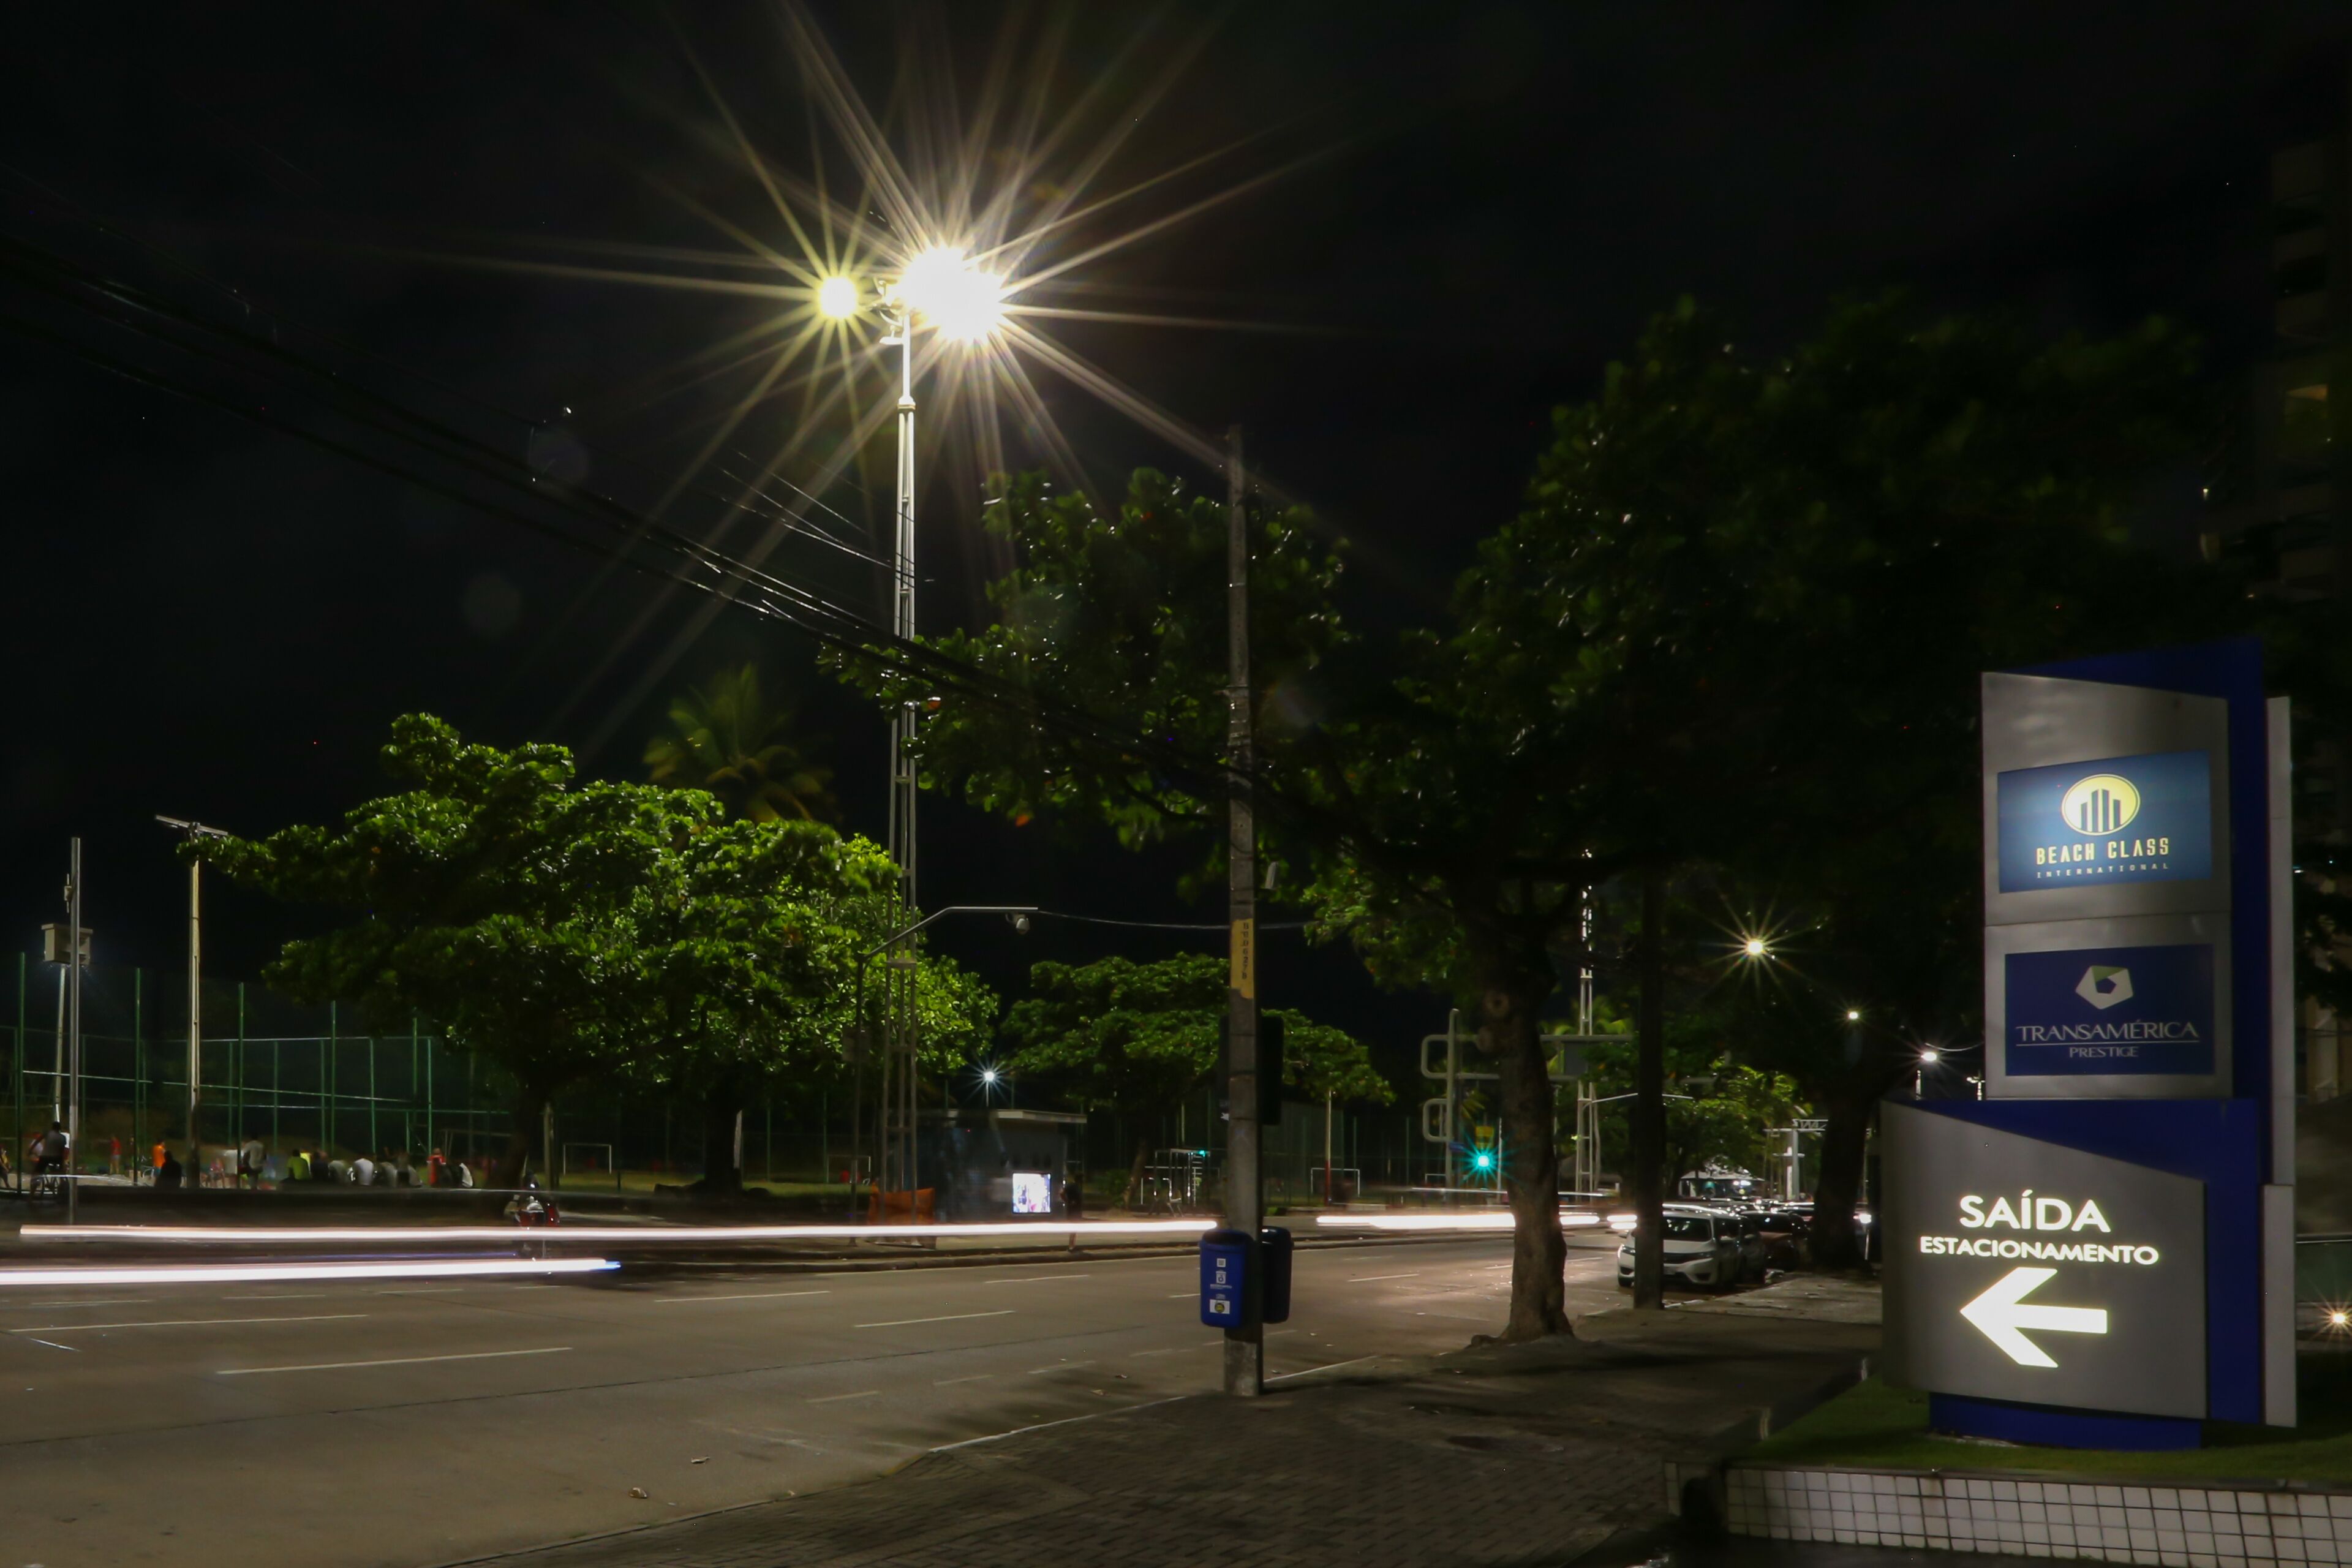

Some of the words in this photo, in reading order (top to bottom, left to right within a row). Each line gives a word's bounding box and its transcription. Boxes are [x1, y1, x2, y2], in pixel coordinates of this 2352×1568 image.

[2037, 843, 2095, 865] BEACH
[2108, 837, 2169, 859] CLASS
[2037, 862, 2169, 878] INTERNATIONAL
[2015, 1019, 2199, 1041] TRANSAMÉRICA
[2069, 1046, 2139, 1058] PRESTIGE
[1959, 1189, 2111, 1232] SAÍDA
[1920, 1236, 2159, 1265] ESTACIONAMENTO
